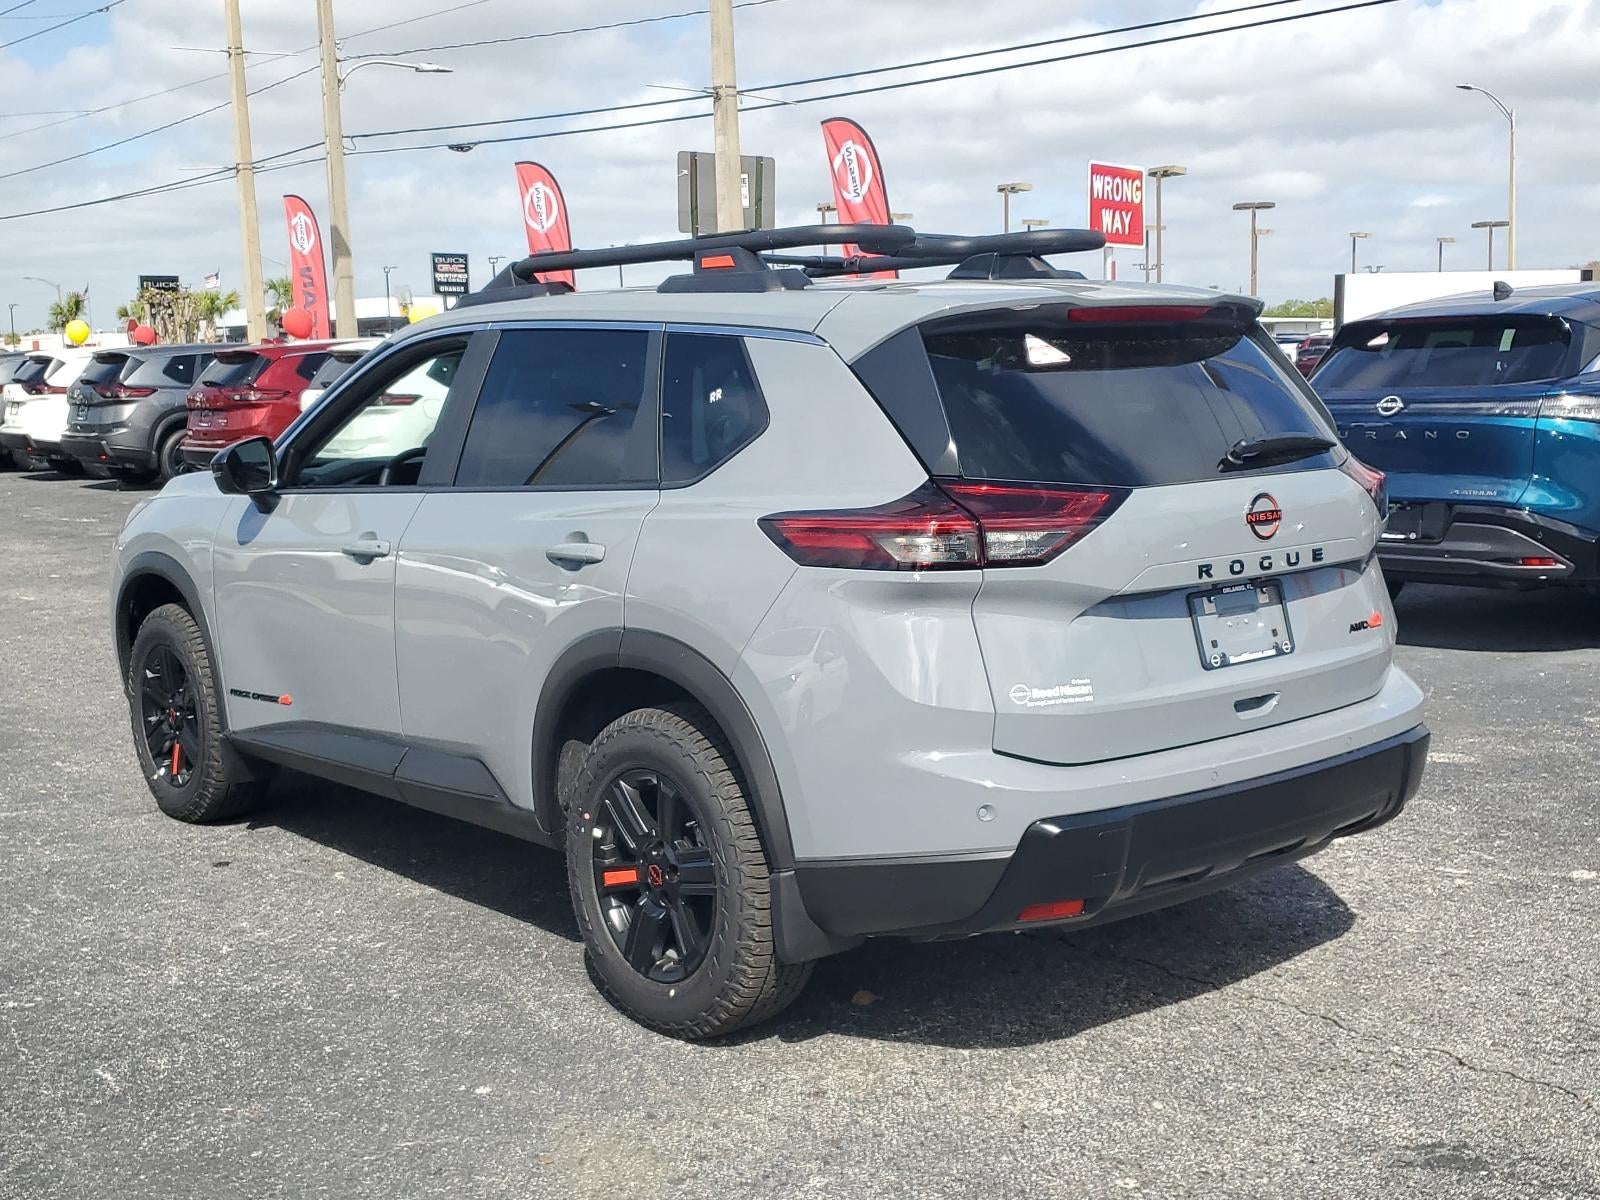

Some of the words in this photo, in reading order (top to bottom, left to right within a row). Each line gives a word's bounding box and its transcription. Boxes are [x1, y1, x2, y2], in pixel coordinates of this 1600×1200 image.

[1092, 173, 1142, 204] WRONG
[1101, 208, 1133, 235] WAY
[437, 264, 466, 273] GMC
[710, 388, 723, 403] RR
[1337, 431, 1470, 440] URANO
[1247, 510, 1282, 524] NISSAN
[1197, 548, 1324, 580] ROGUE
